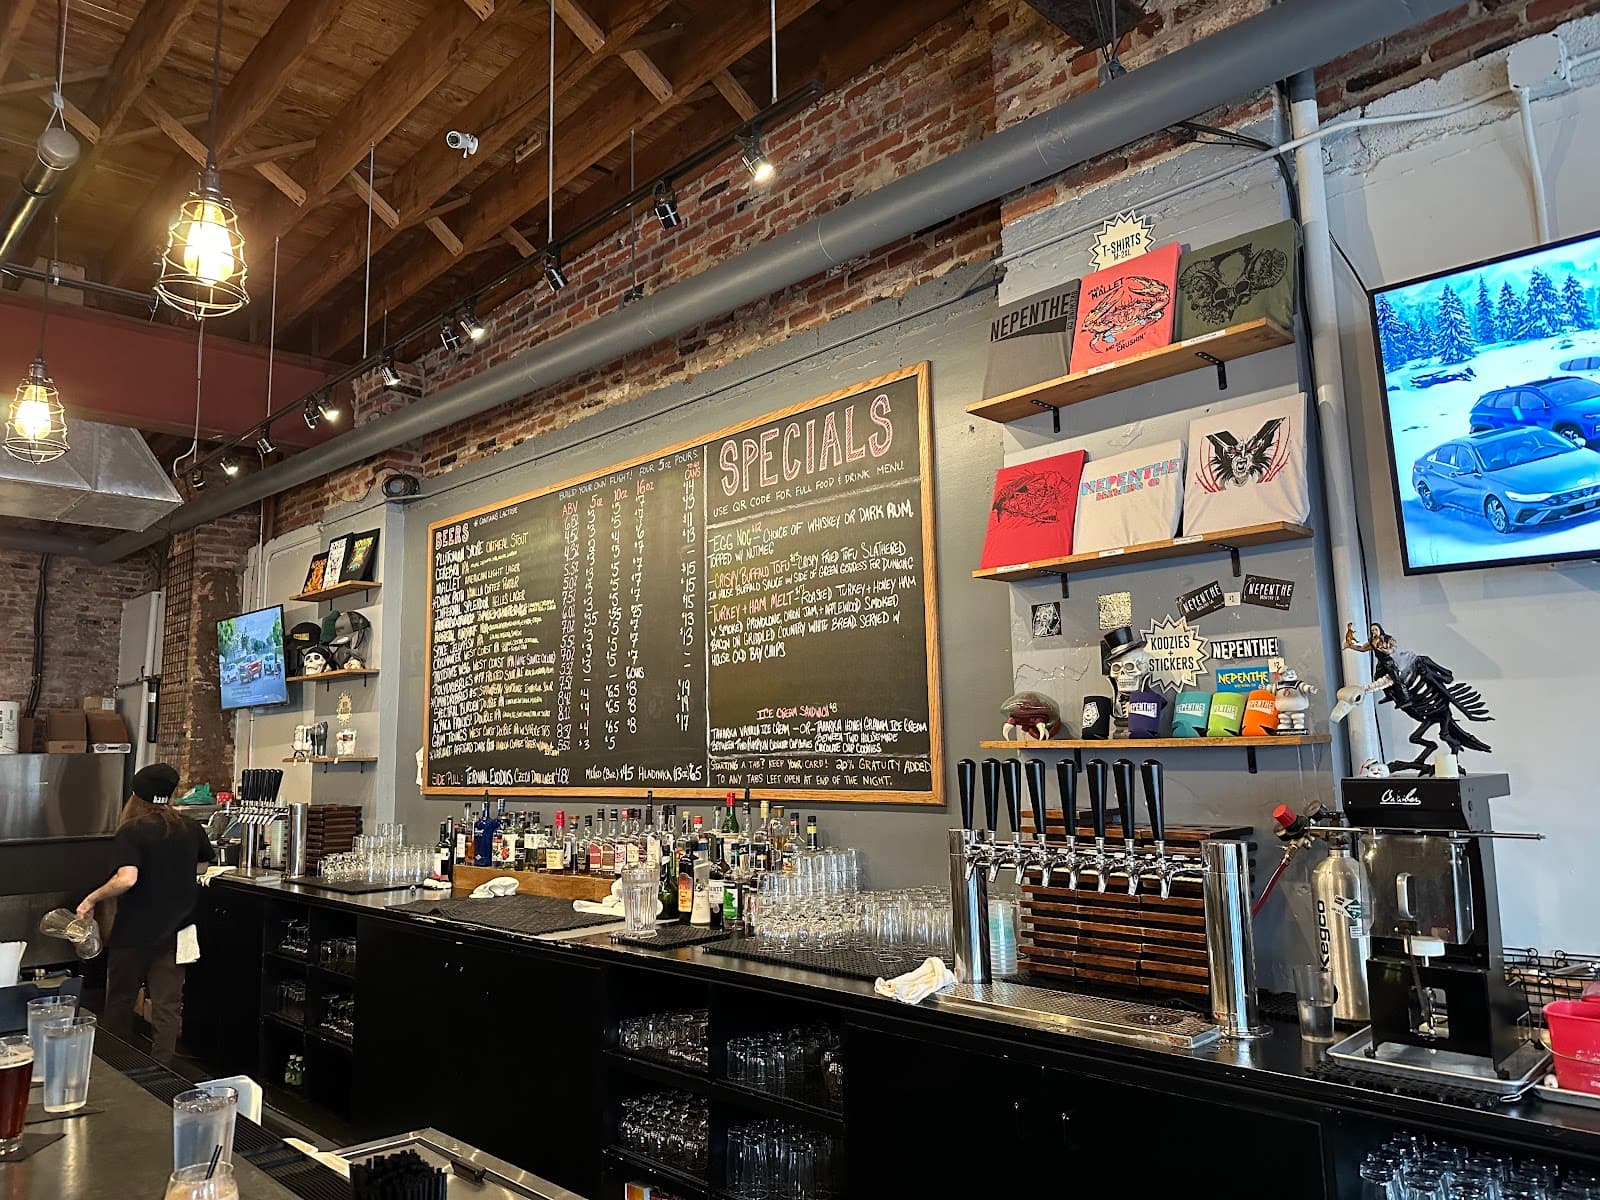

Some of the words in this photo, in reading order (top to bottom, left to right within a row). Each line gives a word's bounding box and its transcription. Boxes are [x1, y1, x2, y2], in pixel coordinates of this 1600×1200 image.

[1102, 233, 1141, 257] T-SHIRTS
[1091, 277, 1124, 300] MALLET
[990, 292, 1071, 342] NEPENTHE
[719, 394, 893, 497] SPECIALS
[558, 488, 578, 501] BUILD
[579, 484, 594, 496] YOUR
[594, 479, 607, 490] OWN
[609, 470, 634, 486] FLIGHT!
[639, 464, 655, 476] FOUR
[1081, 458, 1181, 496] NEPENTHE
[562, 501, 578, 518] ABV
[684, 467, 701, 480] CANS
[713, 504, 728, 518] USE
[733, 499, 747, 512] QR
[750, 494, 771, 507] CODE
[775, 489, 792, 501] FOR
[795, 485, 813, 497] FULL
[815, 477, 835, 490] FOOD
[845, 470, 871, 485] DRINK
[435, 522, 470, 551] BEERS
[736, 528, 752, 547] NOG
[763, 526, 788, 544] CHOICE
[790, 521, 804, 536] OF
[808, 514, 840, 534] WHISKEY
[845, 508, 856, 525] OR
[859, 504, 884, 523] DARK
[510, 531, 529, 548] STOUT
[707, 553, 732, 569] TOPPED
[745, 541, 775, 561] NUTMEG
[740, 566, 769, 586] BUFFALO
[769, 559, 790, 575] TOFU
[797, 554, 819, 571] CRISPY
[821, 549, 840, 564] FRIED
[840, 546, 858, 561] TOFU
[860, 540, 906, 560] SLATHERED
[435, 576, 462, 596] MALLET
[487, 567, 505, 578] LIGHT
[505, 562, 521, 574] LAGER
[484, 581, 501, 594] COFFEE
[736, 582, 761, 598] BUFFALO
[762, 576, 783, 591] SAUCE
[793, 572, 808, 584] SIDE
[810, 569, 816, 580] OF
[819, 565, 839, 579] GREEN
[840, 560, 867, 575] GODDESS
[869, 558, 882, 570] FOR
[882, 556, 914, 573] DUNKING
[749, 596, 767, 616] HAM
[771, 590, 795, 609] MELT
[801, 586, 832, 605] ROASTED
[835, 582, 866, 598] TURKEY
[873, 577, 896, 594] HONEY
[898, 575, 917, 590] HAM
[1183, 584, 1221, 614] NEPENTHE
[1248, 583, 1293, 597] NEPENTHE
[718, 620, 743, 637] SMOKED
[824, 598, 862, 616] APPLEWOOD
[864, 594, 899, 611] SMOKED
[710, 637, 731, 653] BACON
[733, 635, 742, 648] ON
[743, 627, 776, 646] GRIDDLED
[777, 621, 806, 639] COUNTRY
[808, 621, 829, 634] WHITE
[831, 616, 857, 632] BREAD
[859, 611, 890, 629] SERVED
[1151, 635, 1190, 650] KOOZIES
[732, 648, 746, 665] OLD
[749, 646, 762, 664] BAY
[764, 641, 786, 659] CHIPS
[1212, 638, 1279, 659] NEPENTHE!
[1149, 656, 1194, 671] STICKERS
[1217, 671, 1269, 685] NEPENTHE
[756, 708, 774, 720] ICE
[776, 706, 797, 719] CREAM
[760, 723, 772, 735] ICE
[772, 721, 790, 736] CREAM
[844, 717, 863, 733] HONEY
[890, 719, 903, 732] ICE
[903, 718, 928, 733] CREAM
[815, 731, 843, 743] BETWEEN
[843, 731, 858, 744] TWO
[856, 742, 882, 753] COOKIES
[489, 767, 514, 786] EXODUS
[711, 759, 739, 771] STARTING
[741, 760, 746, 769] A
[769, 759, 783, 769] KEEP
[787, 759, 802, 769] YOUR
[805, 759, 829, 769] CARD!
[835, 758, 855, 772] 20%
[858, 757, 900, 772] GRATUITY
[903, 760, 931, 775] ADDED
[716, 773, 726, 785] TO
[729, 774, 742, 785] ANY
[746, 773, 764, 785] TABS
[767, 774, 782, 784] LEFT
[784, 774, 800, 784] OPEN
[803, 775, 812, 785] AT
[816, 775, 830, 786] END
[832, 775, 841, 785] OF
[844, 775, 859, 785] THE
[863, 775, 893, 787] NIGHT.
